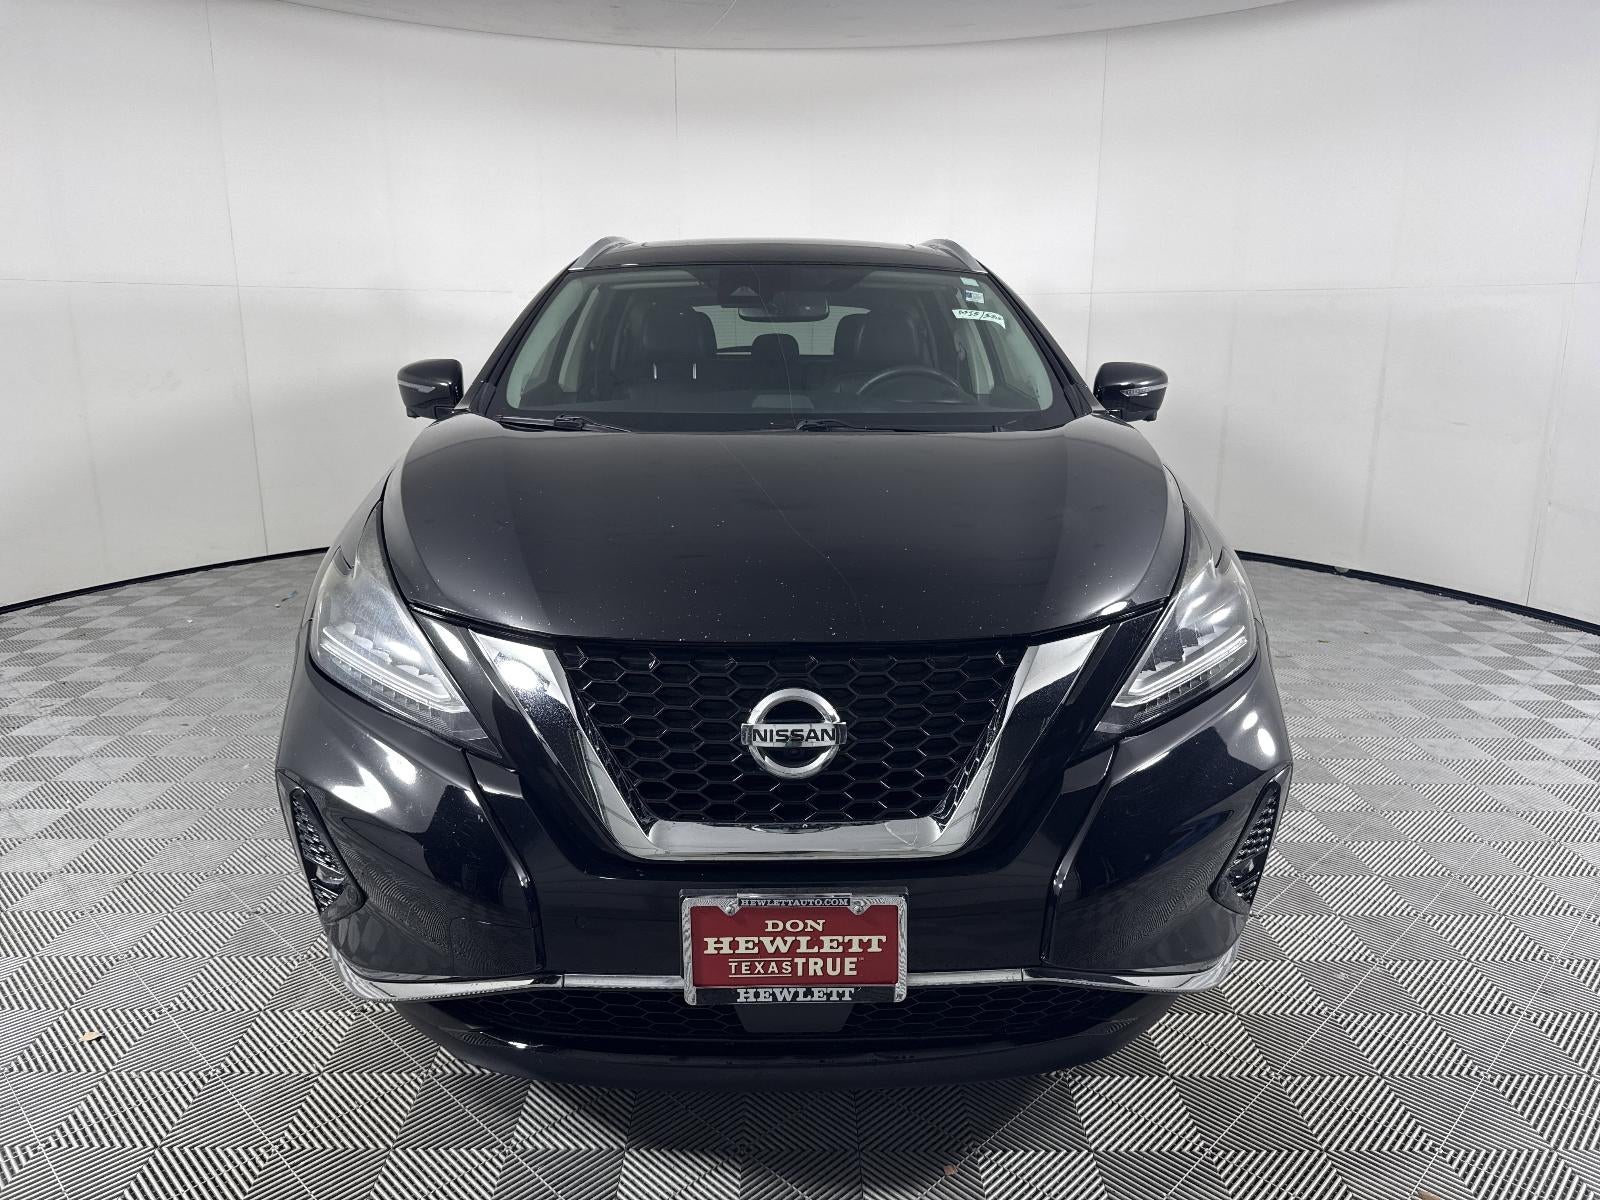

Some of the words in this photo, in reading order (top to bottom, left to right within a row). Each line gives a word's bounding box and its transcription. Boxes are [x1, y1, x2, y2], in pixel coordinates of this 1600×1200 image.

[752, 728, 836, 743] NISSAN
[740, 898, 849, 907] HEWLETTAUTO.COM
[764, 919, 826, 932] DON
[703, 935, 887, 955] HEWLETT
[736, 987, 855, 1003] HEWLETT
